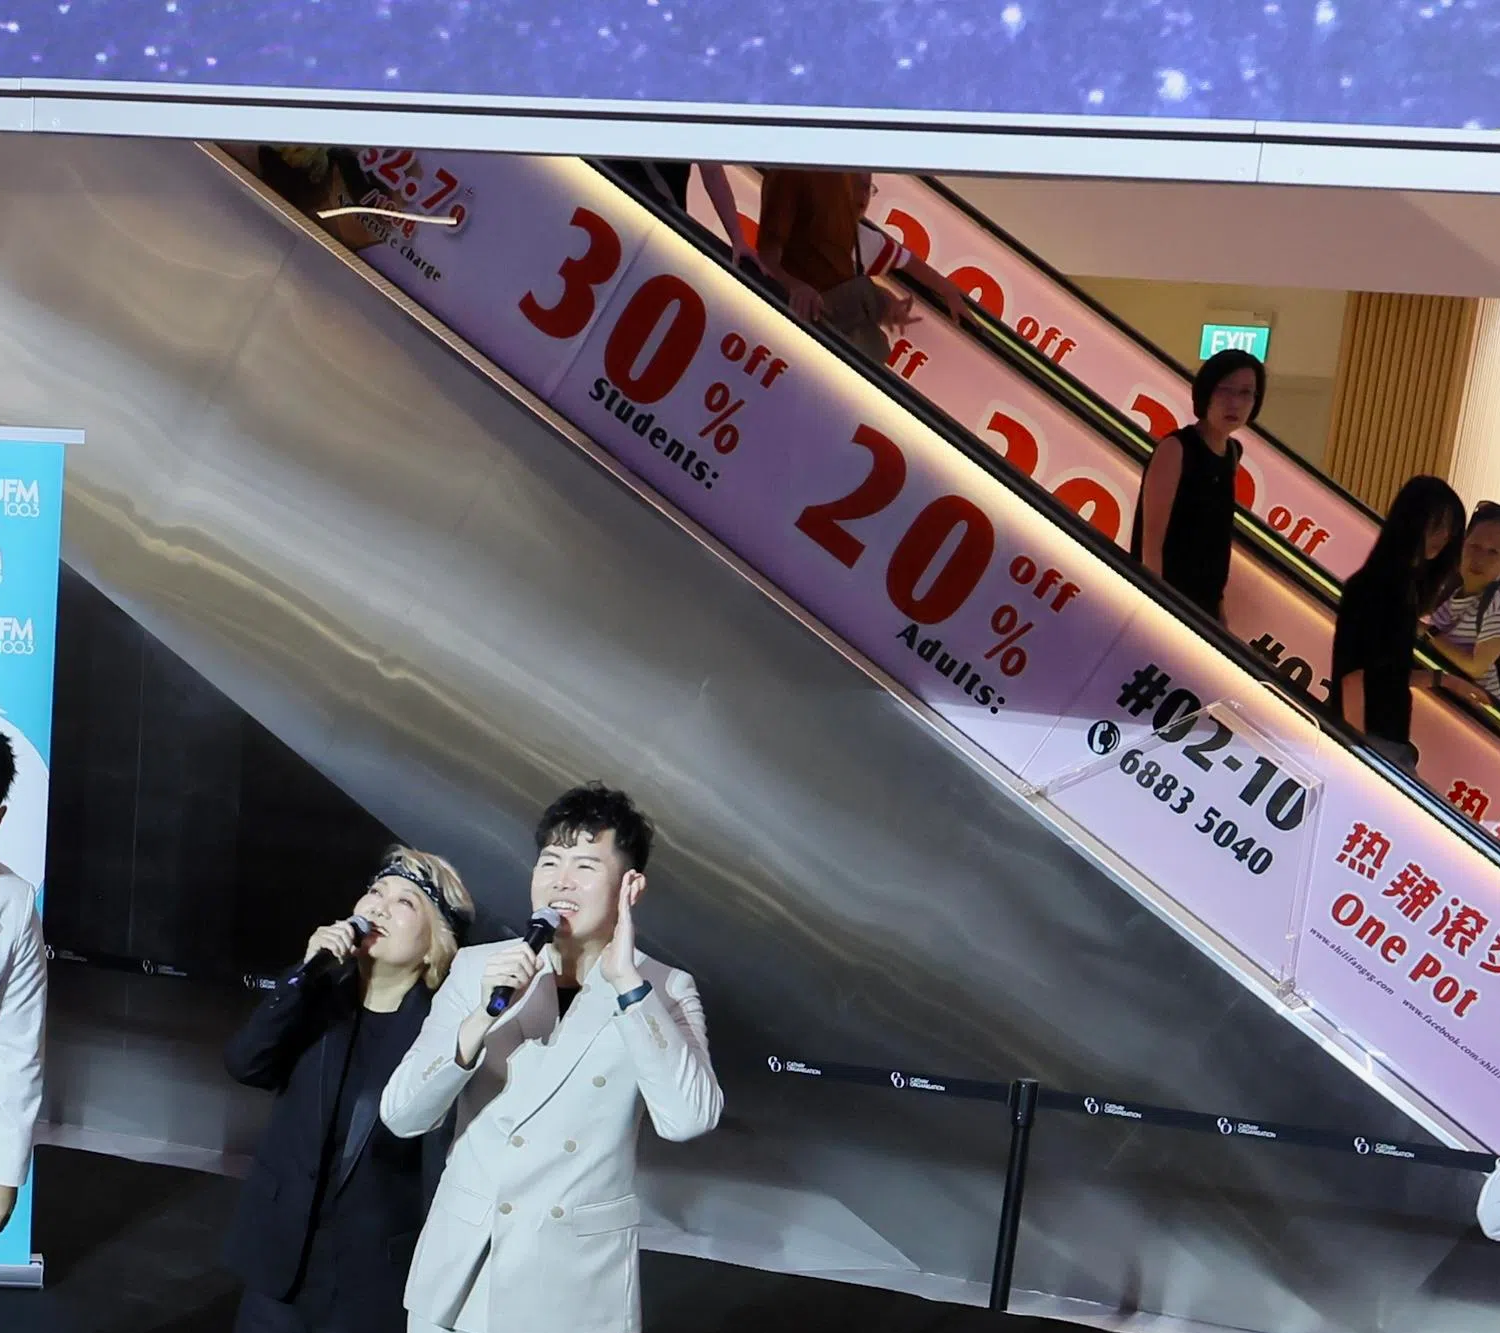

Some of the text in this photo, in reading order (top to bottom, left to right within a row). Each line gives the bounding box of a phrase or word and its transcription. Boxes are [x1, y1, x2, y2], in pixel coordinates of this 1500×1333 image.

[400, 245, 442, 282] charge
[720, 332, 789, 389] off
[1210, 330, 1258, 356] EXIT
[589, 377, 720, 490] Students:
[1009, 555, 1081, 614] off
[896, 623, 1006, 714] Adults:
[1116, 664, 1318, 831] #02-10
[1119, 749, 1274, 876] 6883 5040
[1331, 893, 1480, 1018] One Pot
